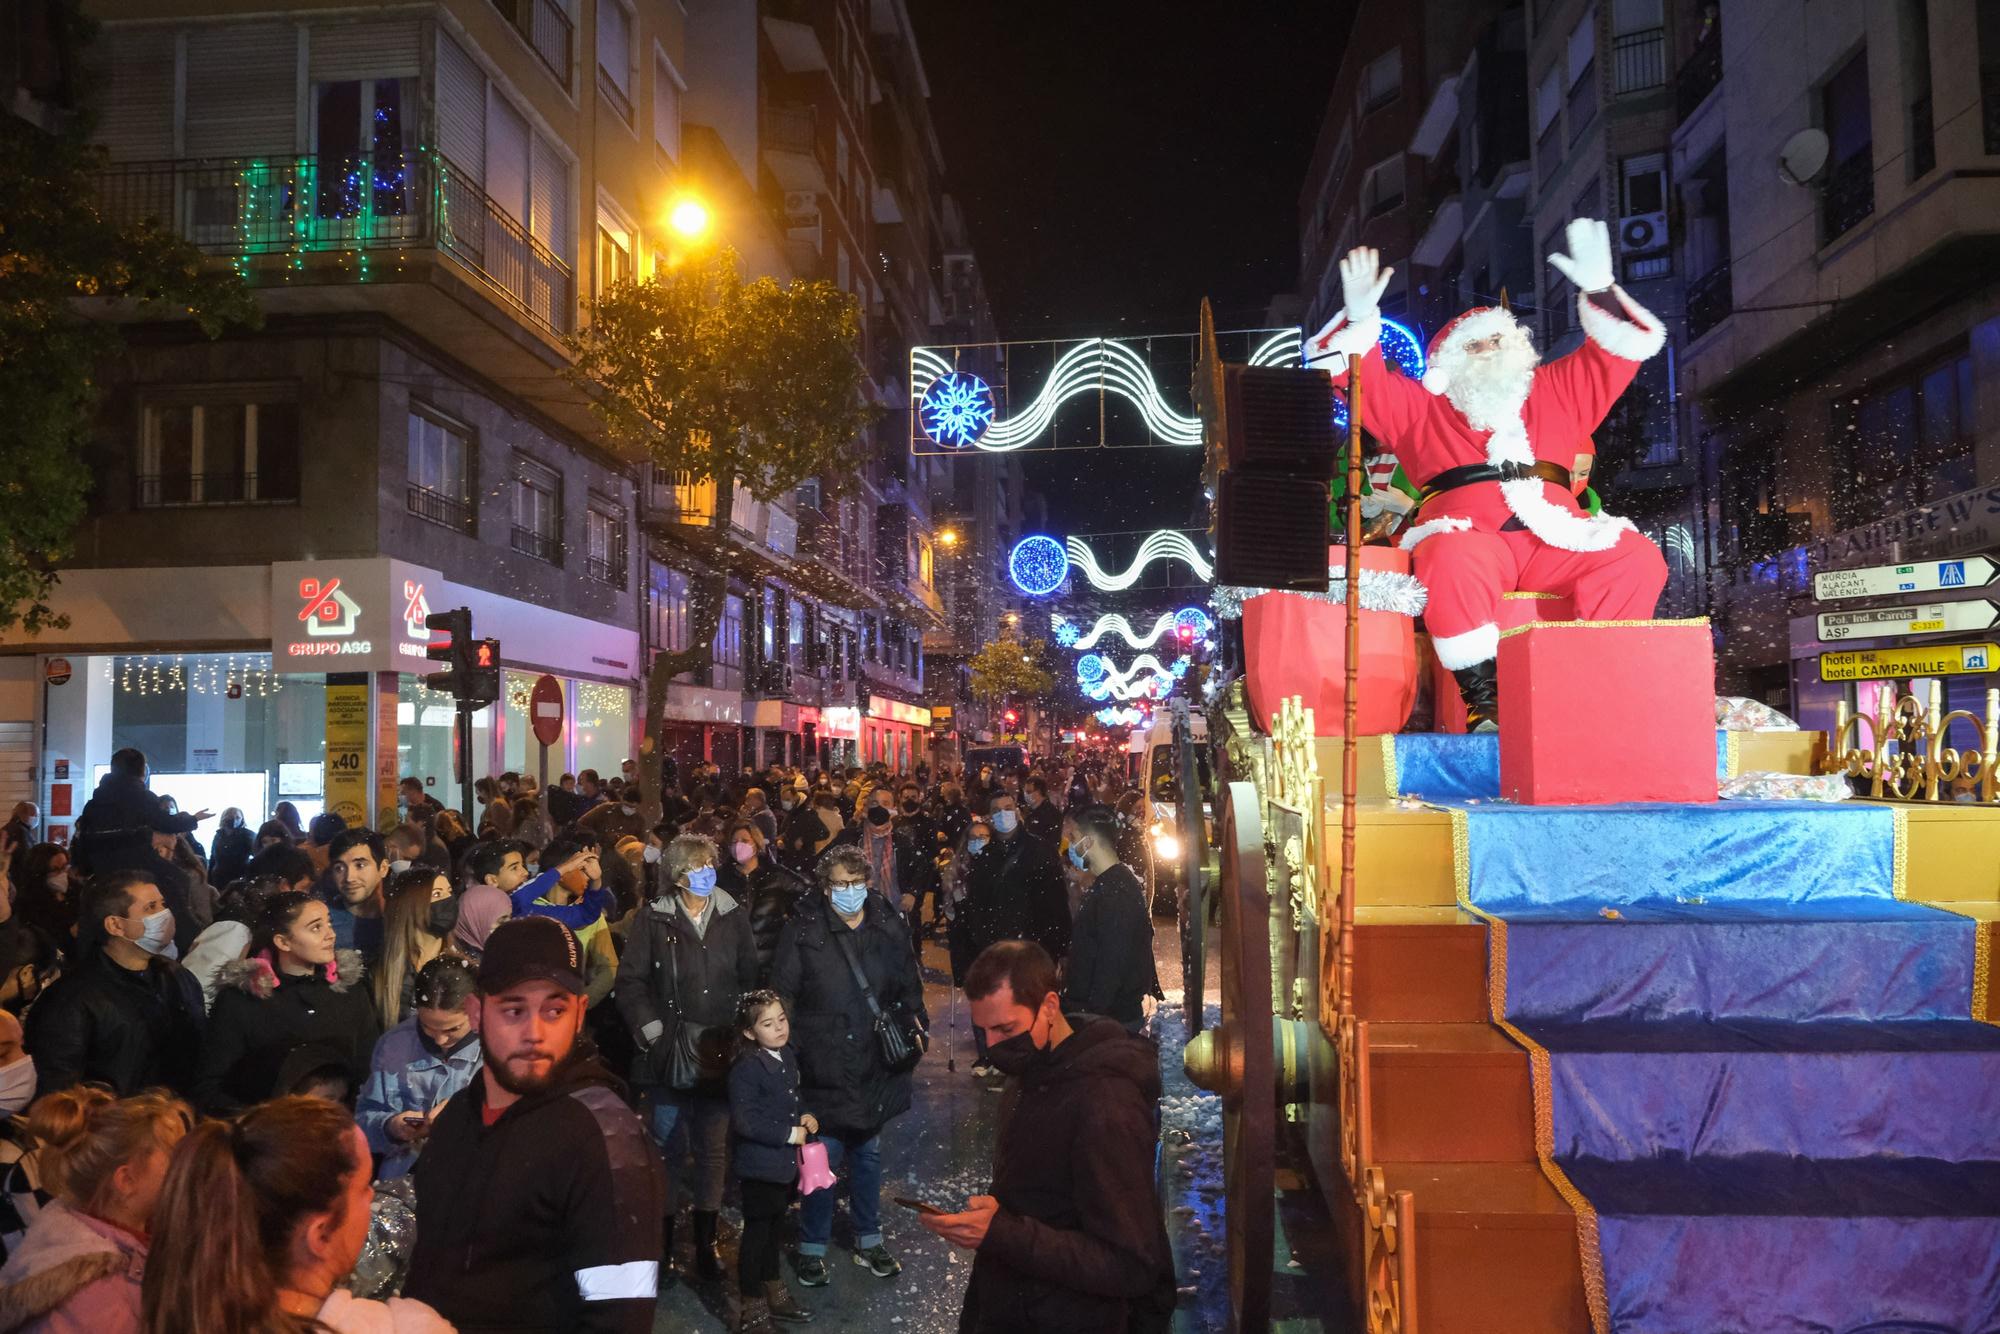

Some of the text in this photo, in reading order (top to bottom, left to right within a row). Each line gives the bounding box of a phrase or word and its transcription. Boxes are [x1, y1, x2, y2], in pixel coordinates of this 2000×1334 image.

[1821, 579, 1865, 590] ALACANT
[1828, 616, 1849, 625] Pol.
[1852, 613, 1873, 623] Ind.
[1825, 627, 1850, 638] ASP
[1825, 654, 1856, 667] hotel
[1826, 661, 1945, 679] hotel CAMPANILLE
[332, 753, 359, 769] x40
[568, 942, 577, 967] CALVIN
